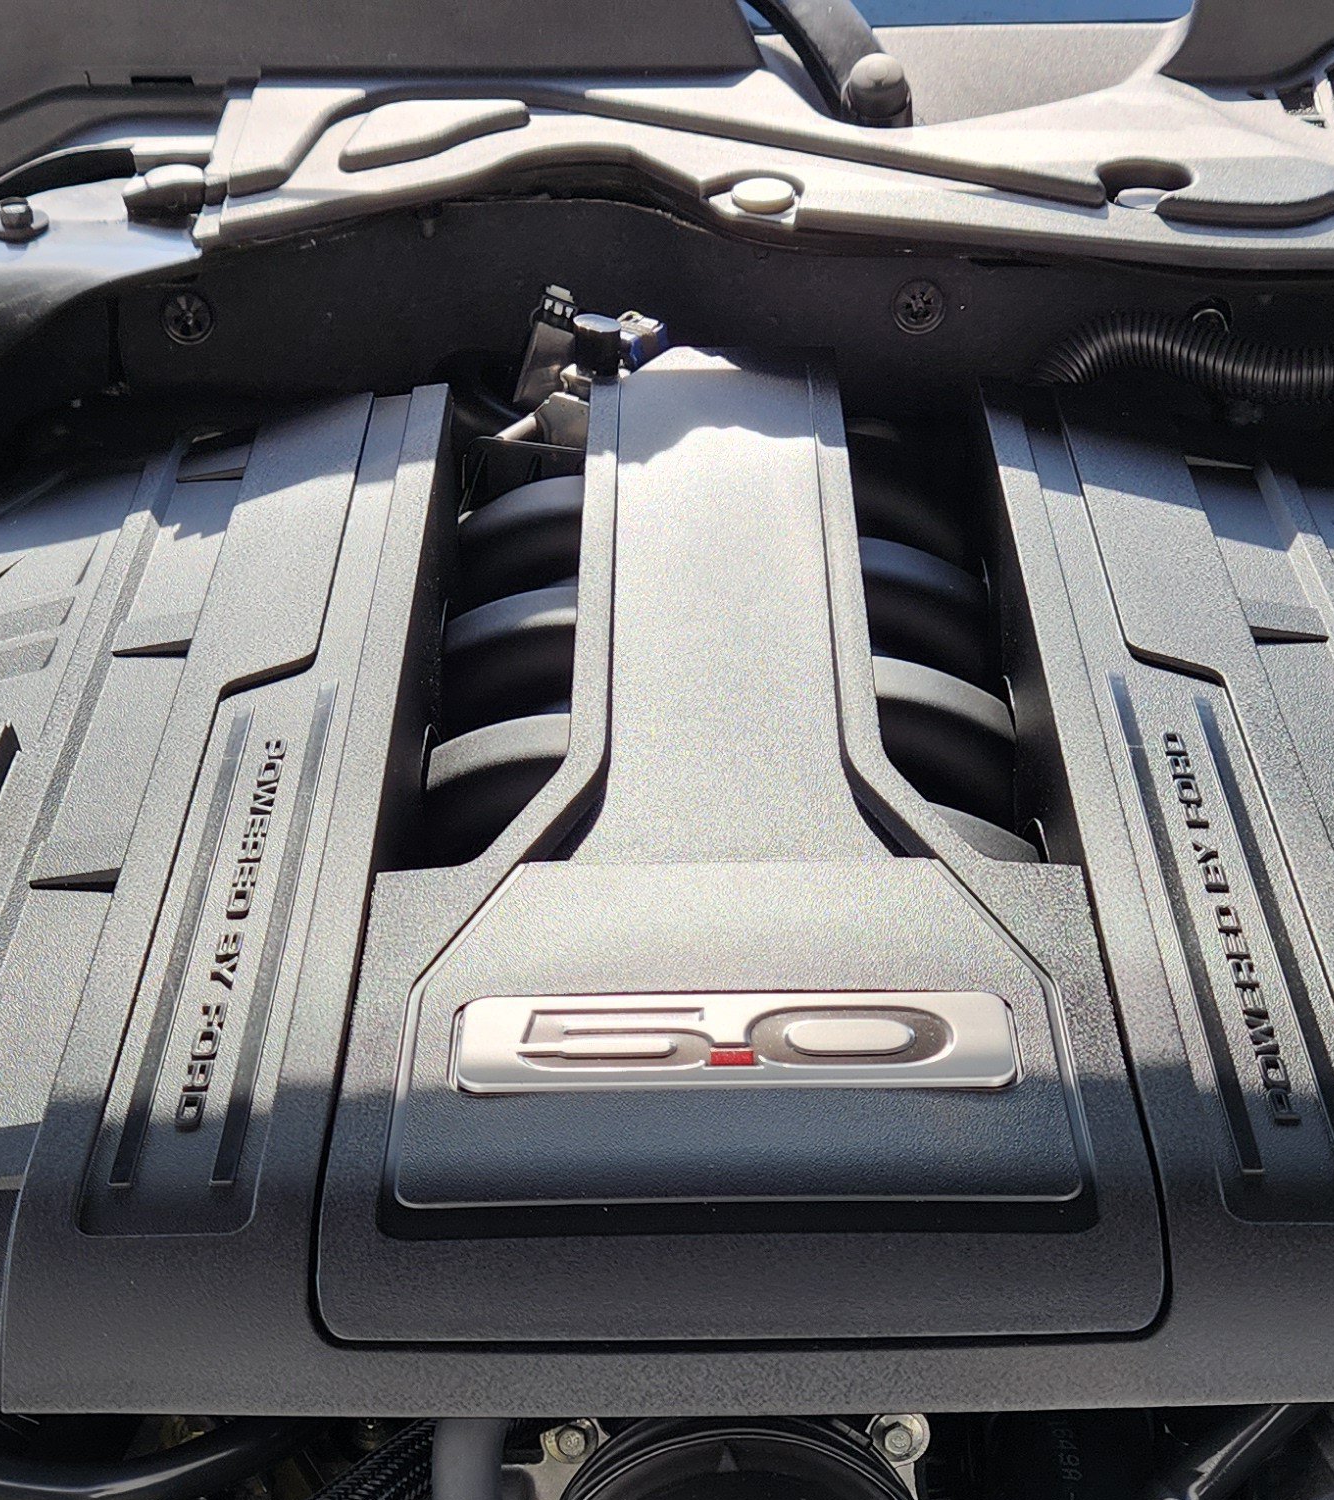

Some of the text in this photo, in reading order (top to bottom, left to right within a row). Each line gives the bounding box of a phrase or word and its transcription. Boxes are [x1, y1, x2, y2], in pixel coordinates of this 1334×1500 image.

[174, 739, 288, 1132] POWERED BY FORD
[515, 1004, 956, 1073] 5.0
[1162, 732, 1302, 1127] POWERED BY FORD
